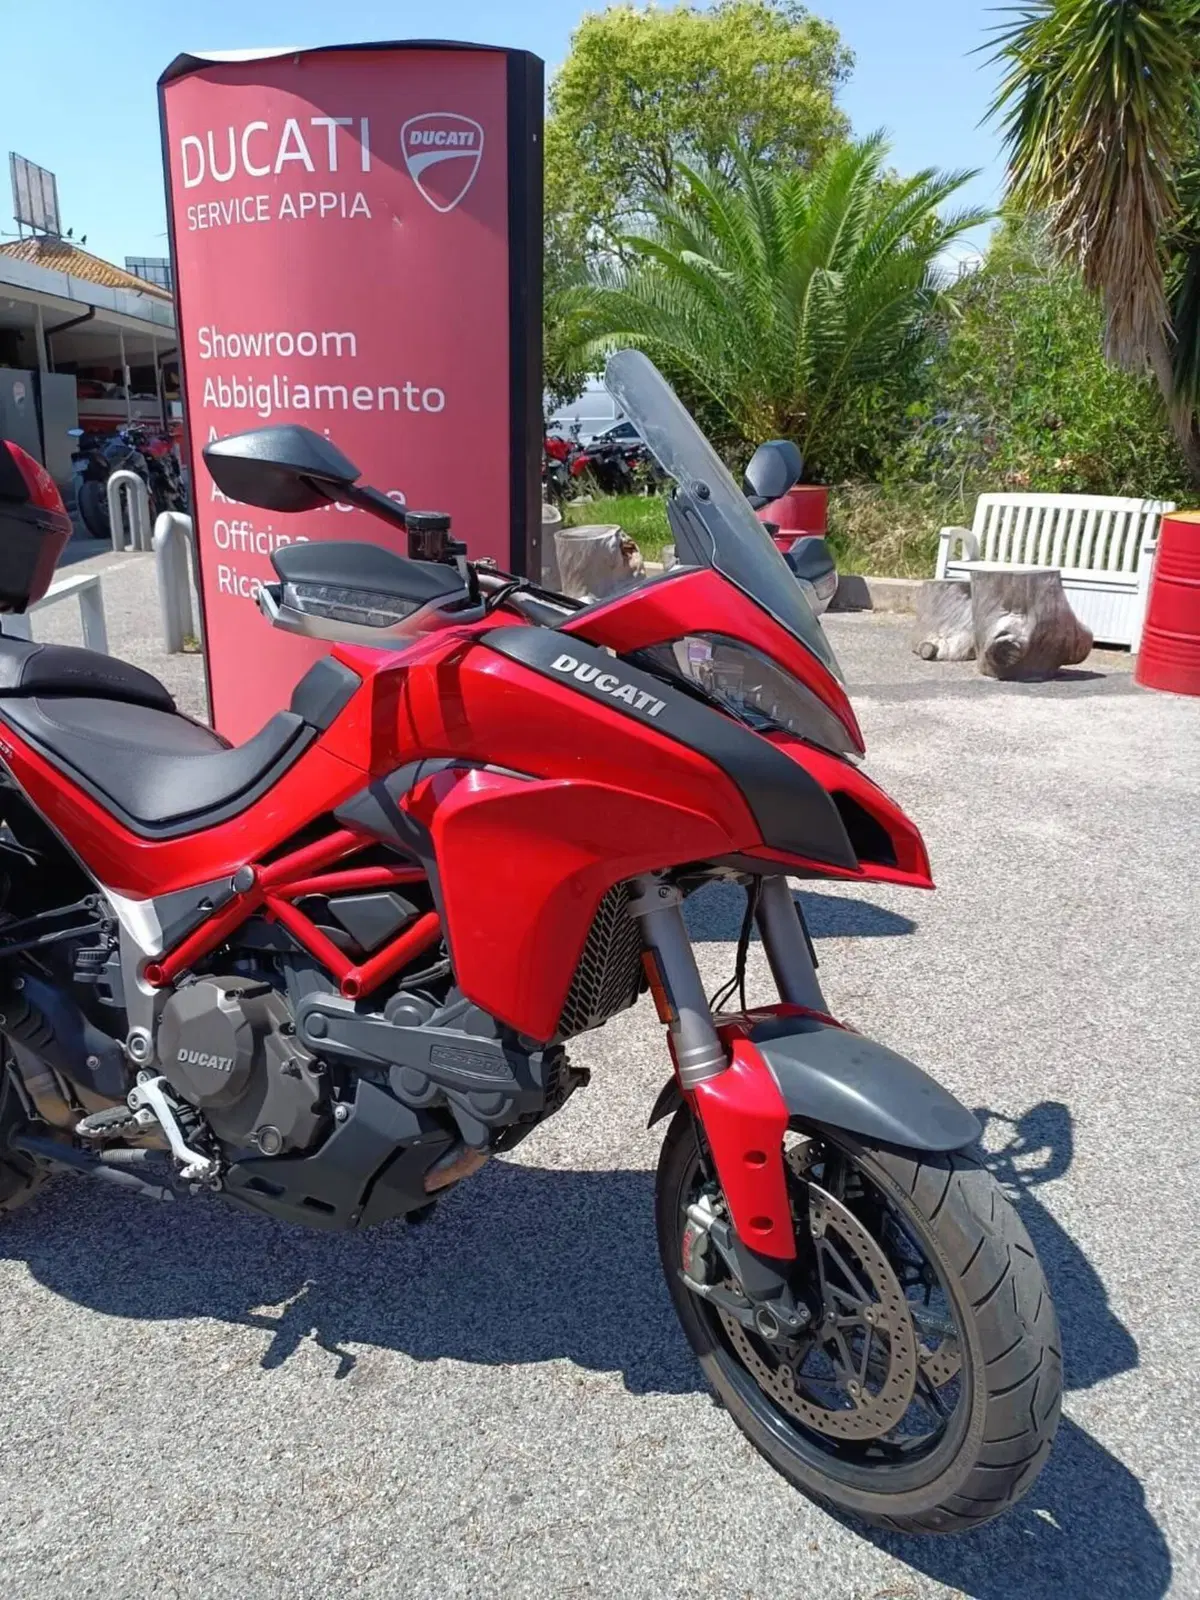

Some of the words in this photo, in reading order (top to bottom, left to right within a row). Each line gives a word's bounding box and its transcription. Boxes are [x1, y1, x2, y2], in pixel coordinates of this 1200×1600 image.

[180, 117, 371, 189] DUCATI
[409, 130, 475, 146] DUCATI
[187, 194, 270, 231] SERVICE
[278, 192, 372, 219] APPIA
[198, 325, 357, 359] Showroom
[203, 374, 446, 418] Abbigliamento
[213, 519, 310, 555] Officin
[550, 653, 667, 718] DUCATI
[177, 1048, 233, 1072] DUCATI
